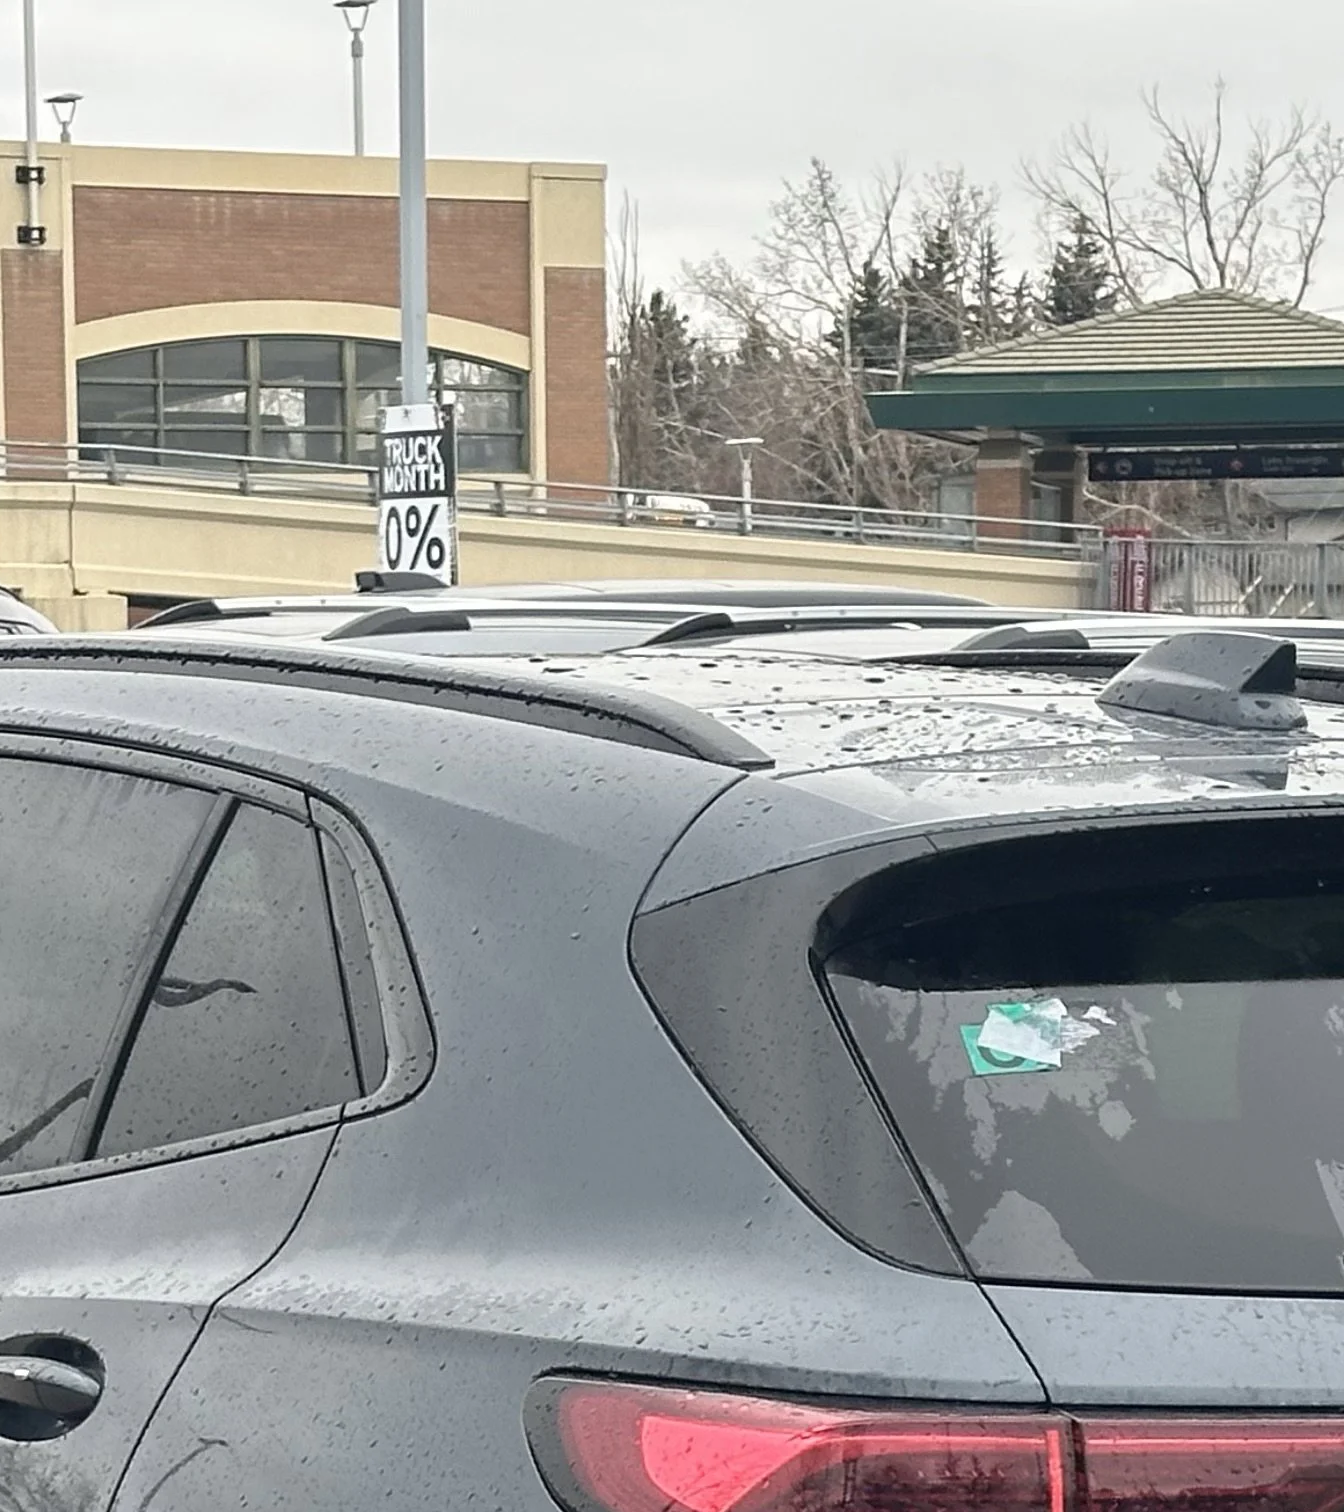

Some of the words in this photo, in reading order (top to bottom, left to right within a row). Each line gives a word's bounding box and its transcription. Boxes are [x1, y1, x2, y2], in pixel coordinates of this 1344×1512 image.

[383, 435, 443, 465] TRUCK
[383, 463, 446, 493] MONTH
[385, 504, 446, 571] 0%
